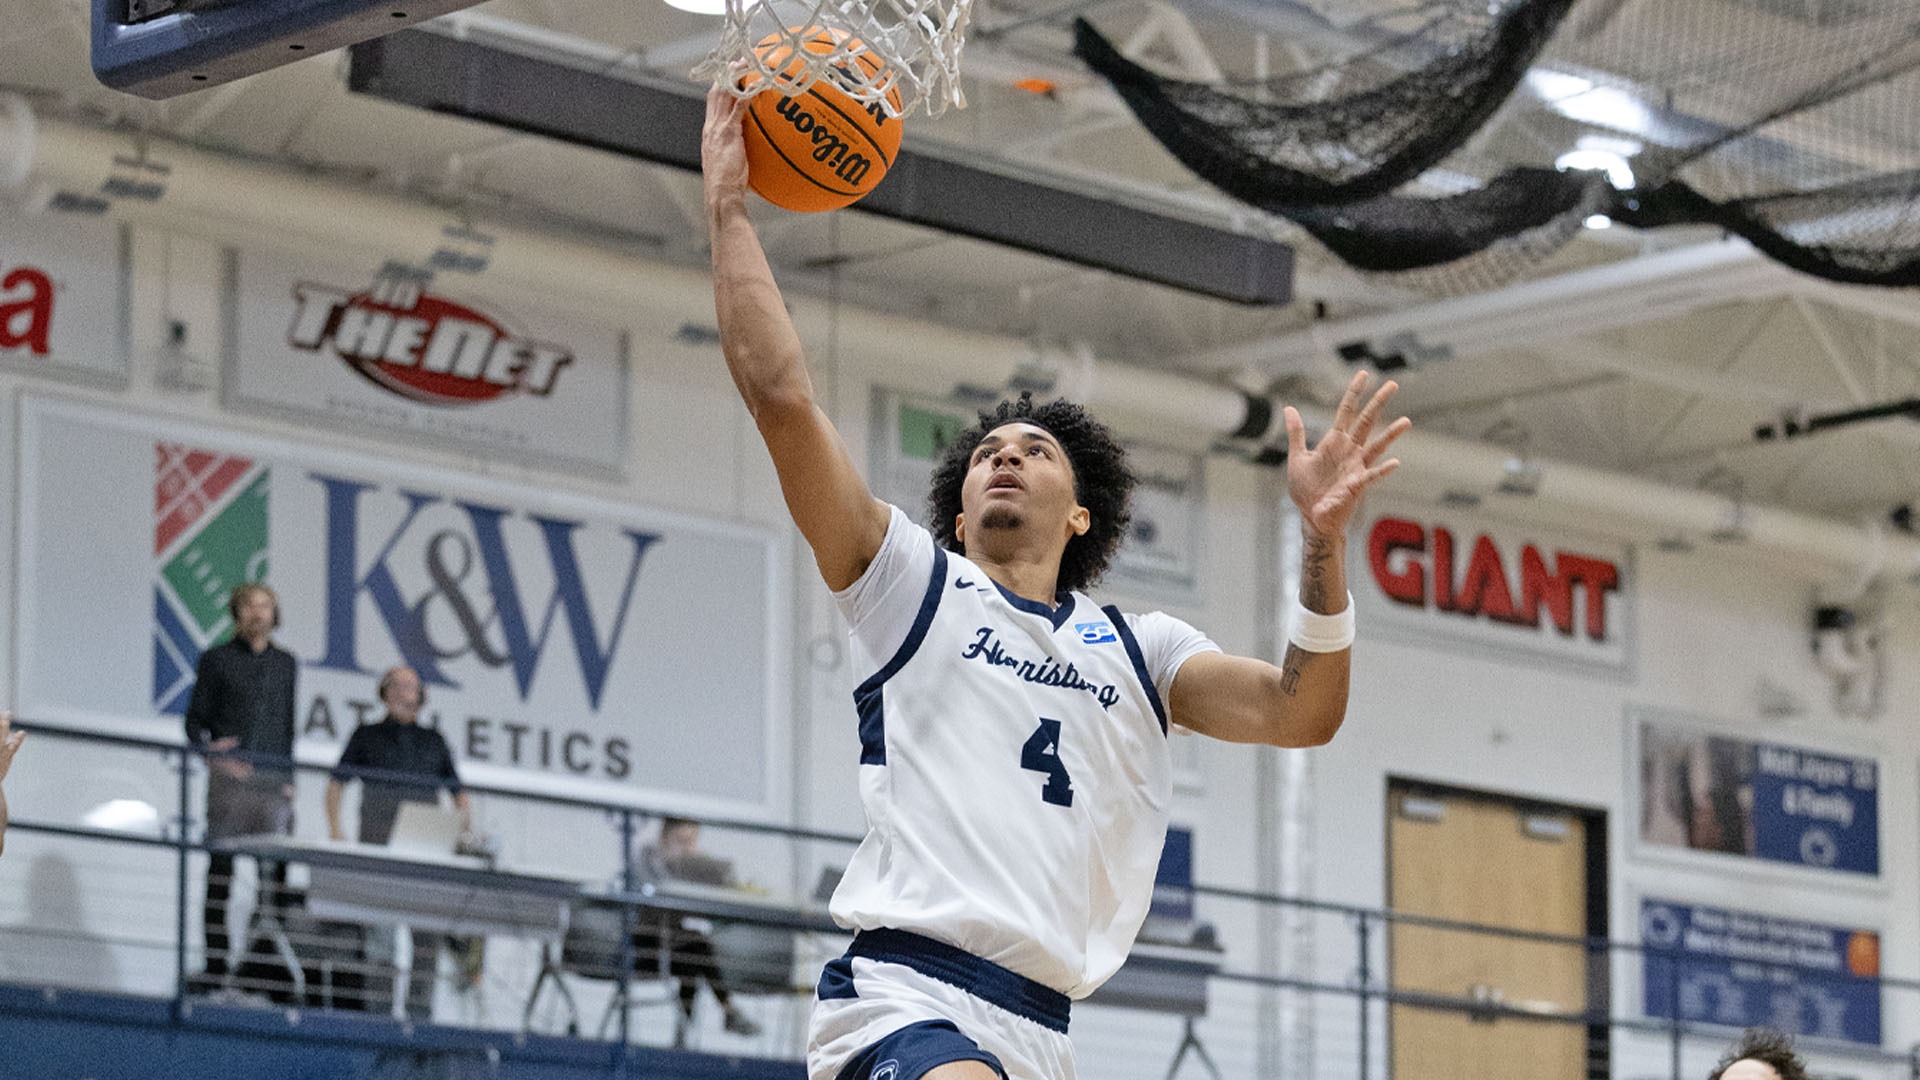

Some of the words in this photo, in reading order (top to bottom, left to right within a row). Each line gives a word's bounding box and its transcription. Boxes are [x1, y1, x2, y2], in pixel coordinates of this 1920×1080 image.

[775, 96, 871, 187] Wilson
[302, 471, 664, 711] K&W
[1368, 517, 1619, 641] GIANT
[961, 626, 1120, 713] Harisbug
[303, 694, 633, 781] ATETICS
[1020, 716, 1075, 808] 4
